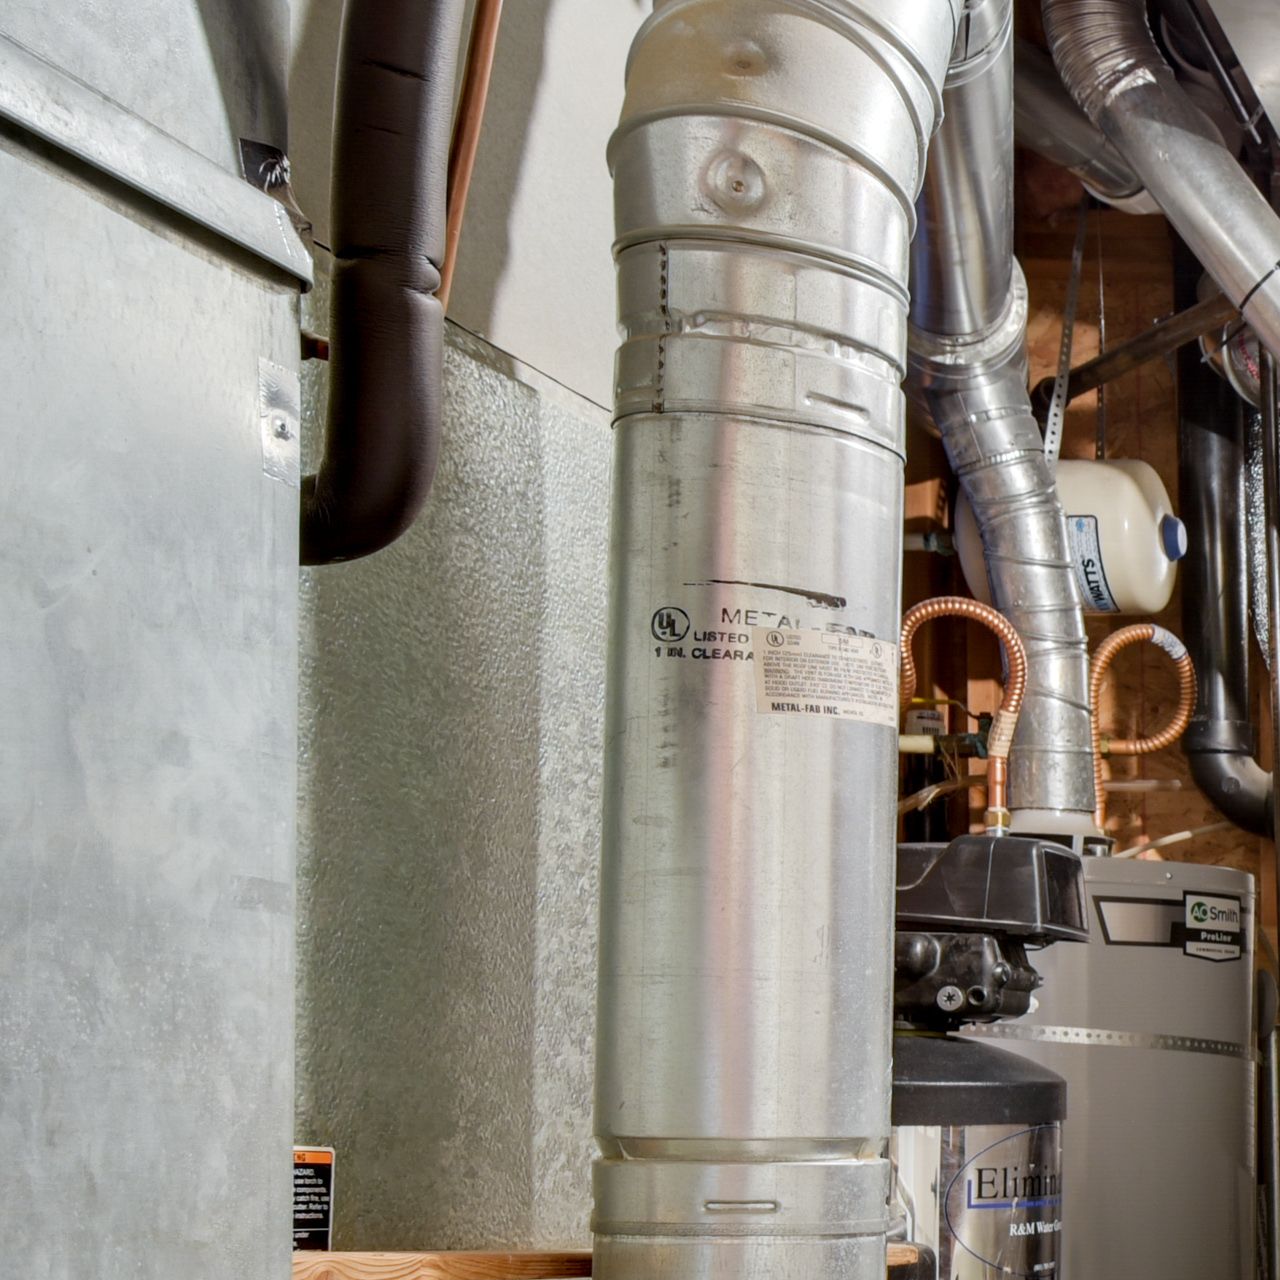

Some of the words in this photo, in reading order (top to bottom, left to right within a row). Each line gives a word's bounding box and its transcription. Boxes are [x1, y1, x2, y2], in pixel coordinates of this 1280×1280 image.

[1082, 558, 1107, 603] WATTS
[694, 631, 749, 644] LISTED
[771, 702, 820, 714] METAL-FAB
[824, 705, 840, 715] INC.
[1210, 906, 1239, 923] Smith
[975, 1165, 1062, 1200] Elimin
[1009, 1221, 1035, 1236] R&M
